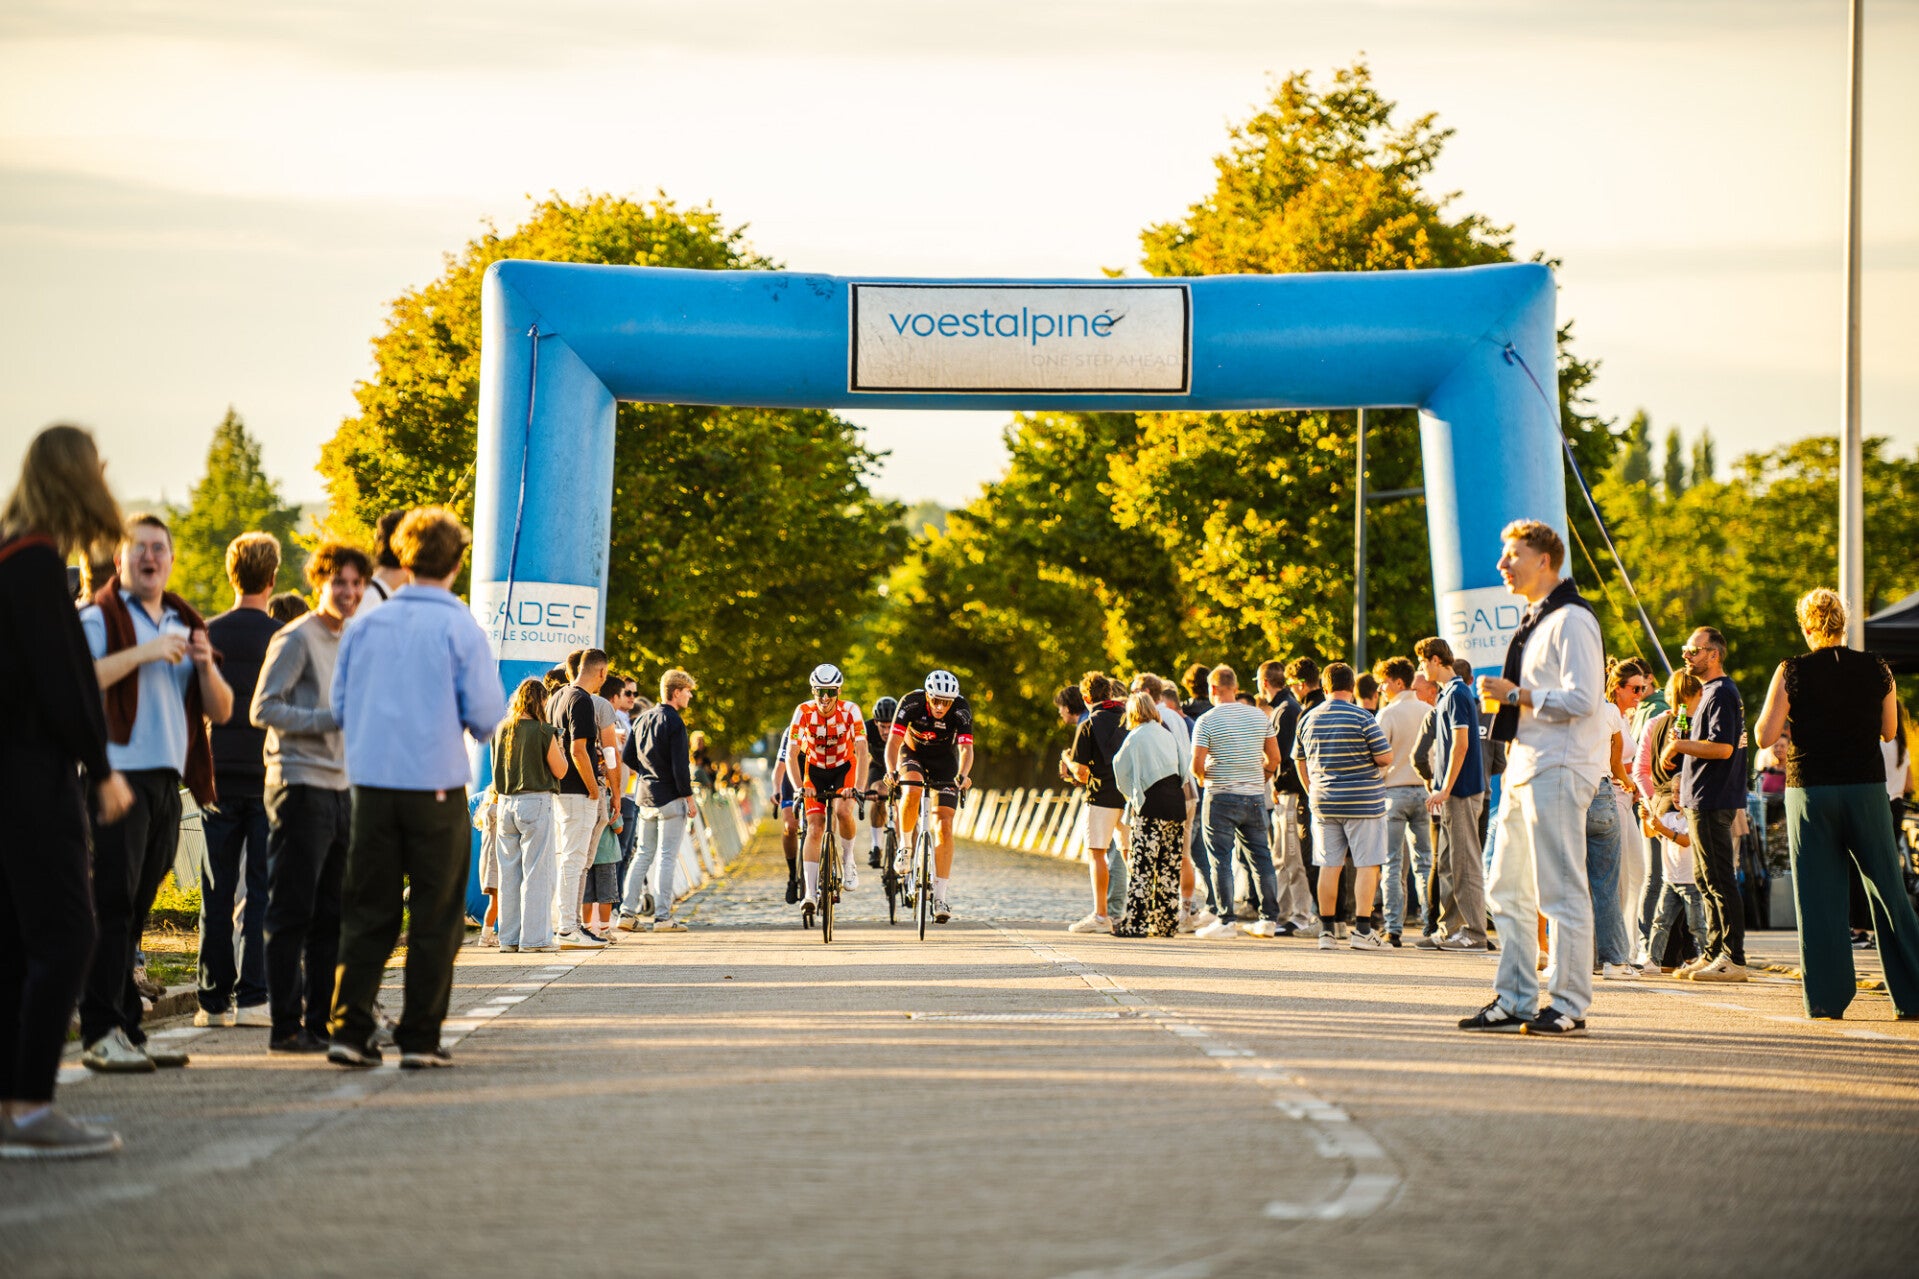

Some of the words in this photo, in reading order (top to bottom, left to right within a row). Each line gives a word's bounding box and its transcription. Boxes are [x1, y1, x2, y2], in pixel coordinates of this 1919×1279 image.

[888, 306, 1114, 346] voestalpine
[1031, 353, 1070, 368] ONE
[1075, 353, 1114, 368] STEP
[1452, 605, 1528, 634] SAD
[520, 630, 591, 646] SOLUTIONS
